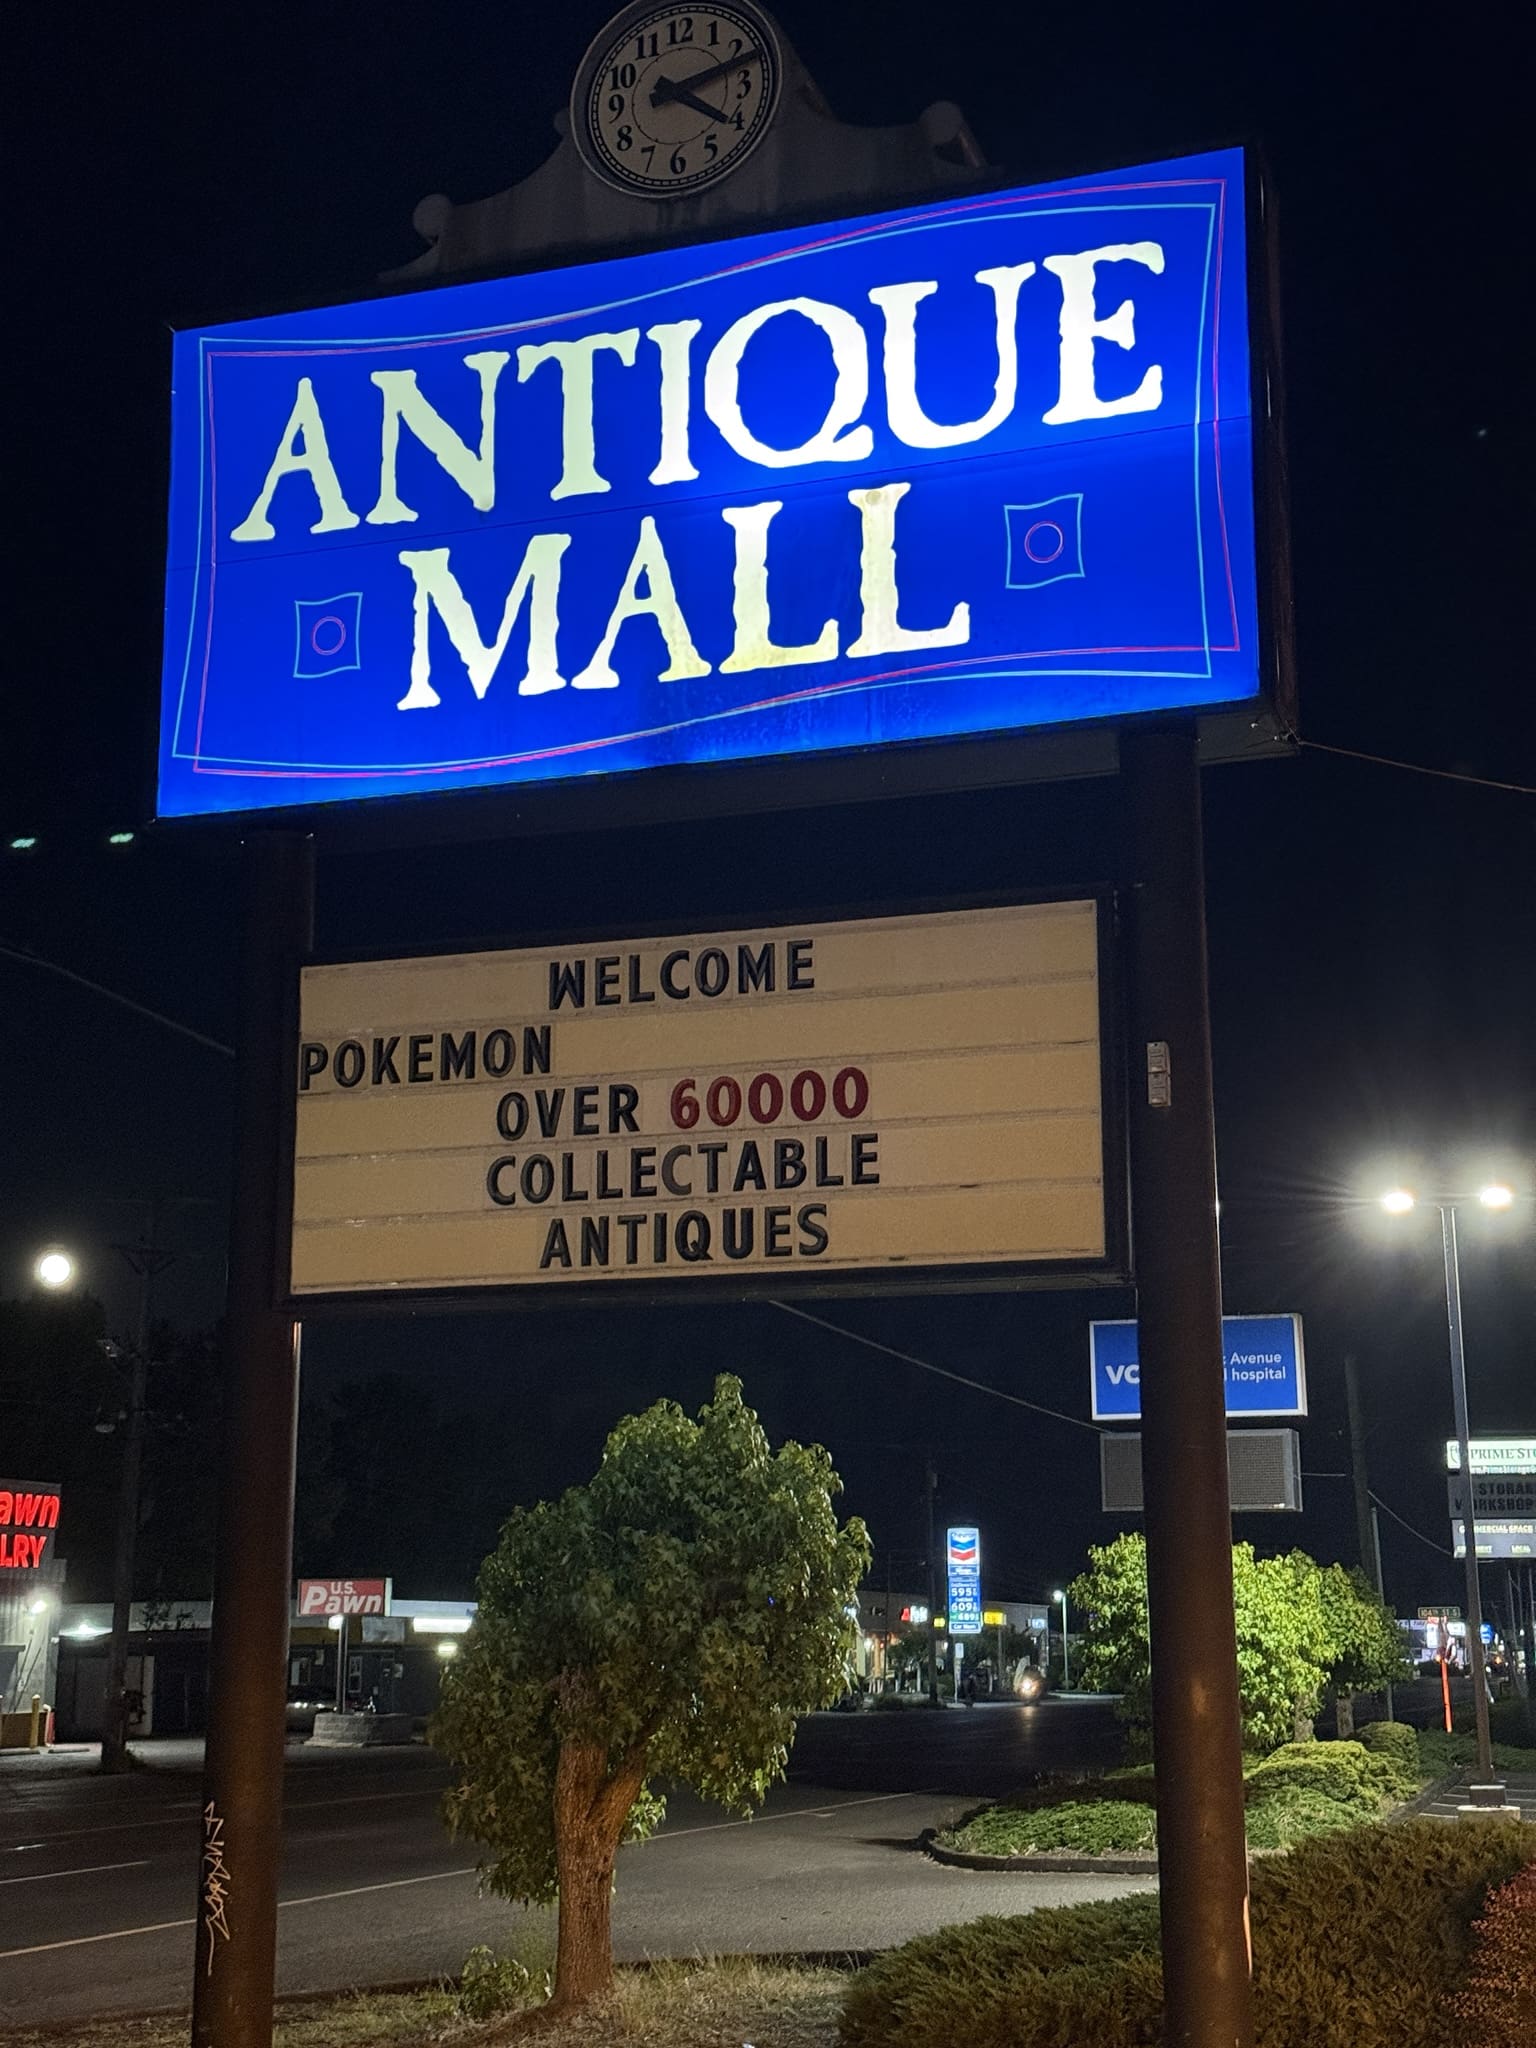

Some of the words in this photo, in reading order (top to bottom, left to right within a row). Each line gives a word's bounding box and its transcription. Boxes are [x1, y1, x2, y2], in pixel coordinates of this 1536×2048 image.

[667, 17, 693, 45] 12
[706, 21, 720, 46] 1
[635, 32, 661, 60] 11
[728, 39, 743, 60] 2
[609, 63, 636, 90] 10
[736, 69, 751, 99] 3
[608, 94, 624, 124] 9
[728, 103, 745, 132] 4
[616, 125, 633, 151] 8
[703, 134, 718, 164] 5
[641, 145, 656, 173] 7
[670, 144, 686, 175] 6
[231, 241, 1165, 541] ANTIQUE
[397, 482, 970, 710] MALL
[548, 939, 814, 1010] WELCOME
[300, 1025, 551, 1090] POKEMON
[496, 1084, 640, 1141] OVER
[670, 1067, 869, 1129] 60000
[487, 1133, 880, 1205] COLLECTABLE
[539, 1203, 828, 1269] ANTIQUES
[1230, 1352, 1282, 1365] Avenue
[1232, 1366, 1286, 1383] hospital
[1471, 1449, 1514, 1459] PRIME
[301, 1585, 383, 1615] Pawn
[330, 1581, 356, 1595] U.S.
